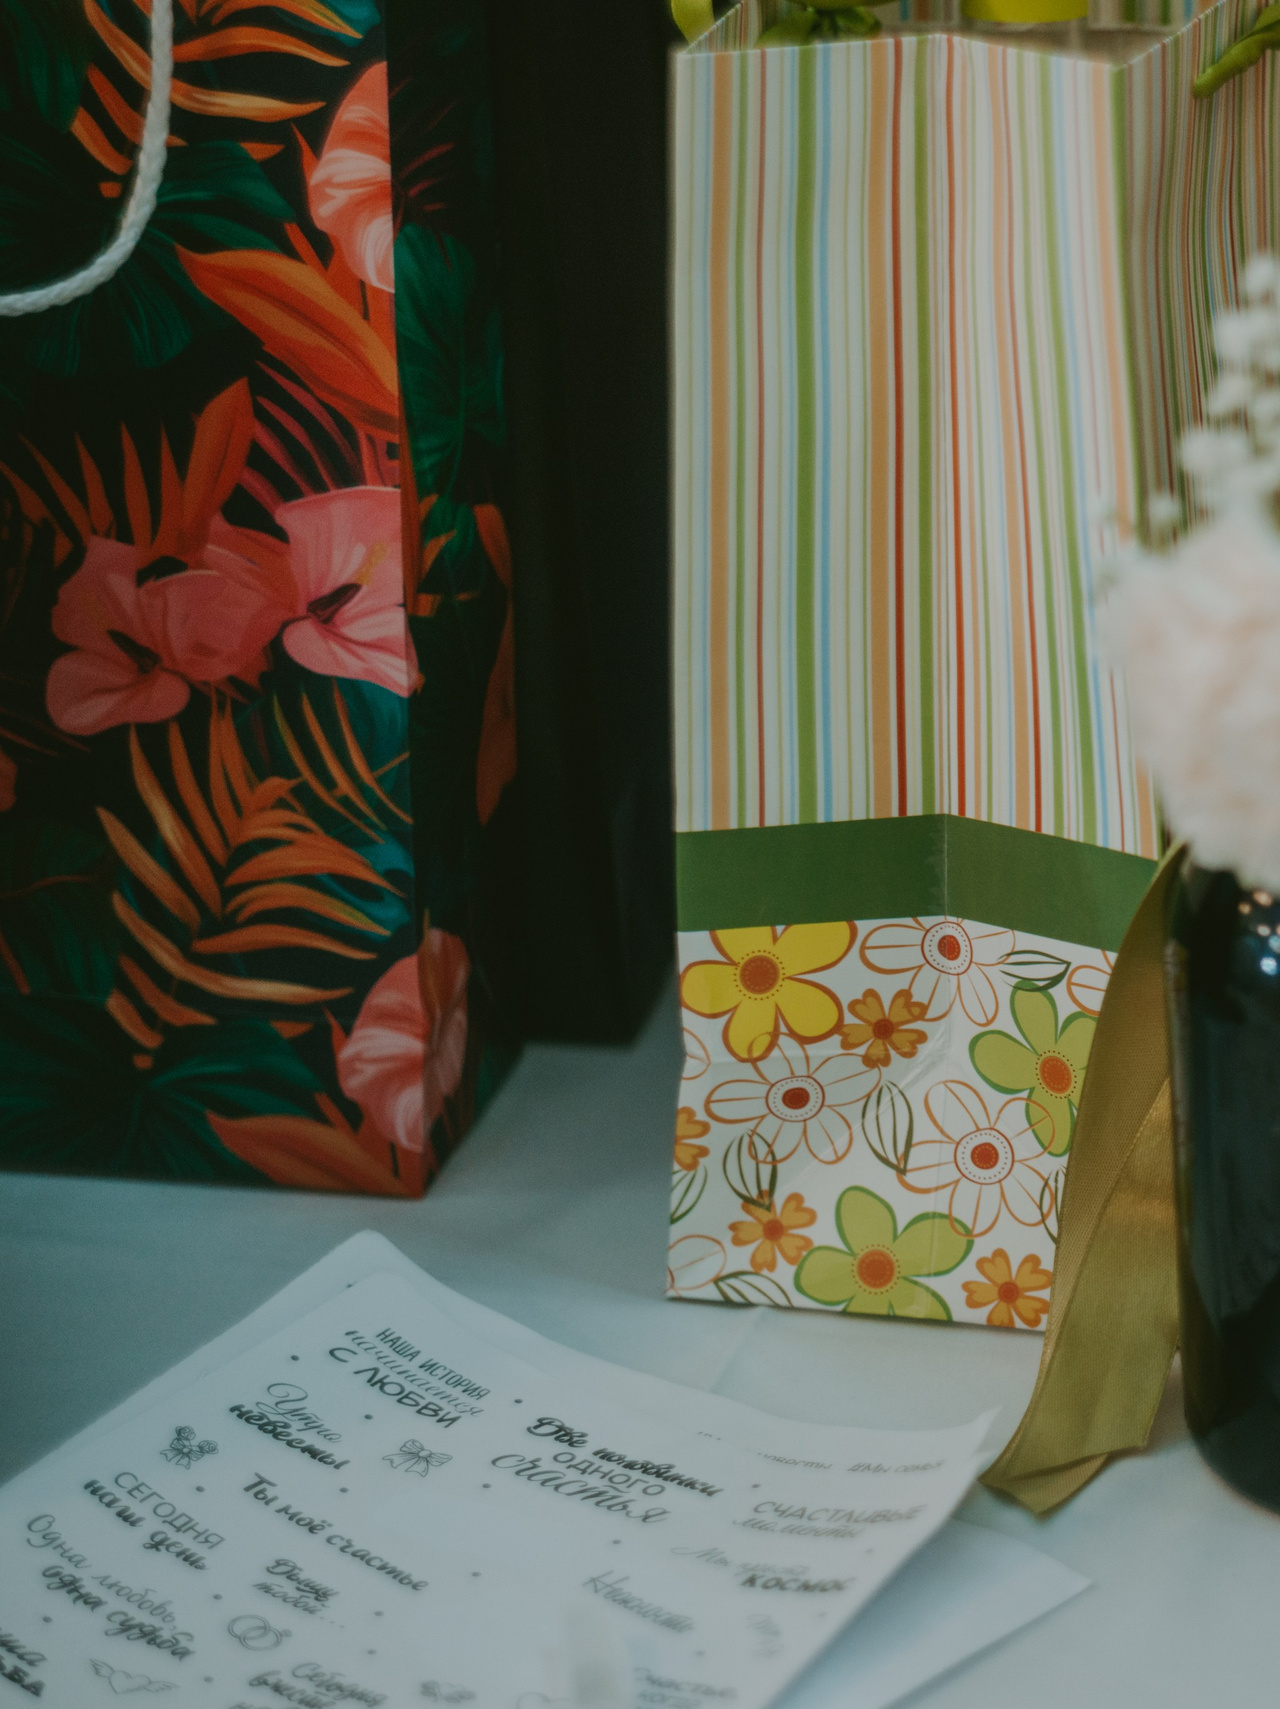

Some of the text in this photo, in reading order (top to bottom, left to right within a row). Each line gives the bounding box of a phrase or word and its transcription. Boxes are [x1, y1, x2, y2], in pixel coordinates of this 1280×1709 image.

[344, 1330, 484, 1416] начинается
[353, 1367, 462, 1428] ЛЮБВИ
[375, 1327, 492, 1401] НАША ИСТОРИЯ
[229, 1403, 351, 1471] невесты
[256, 1382, 343, 1444] Утро
[526, 1417, 724, 1497] Две половинки
[26, 1514, 93, 1569] Одна
[83, 1479, 209, 1571] наш день
[114, 1471, 226, 1550] СЕГОДНЯ
[243, 1472, 430, 1591] Ты моё счастье
[104, 1610, 197, 1661] судьба
